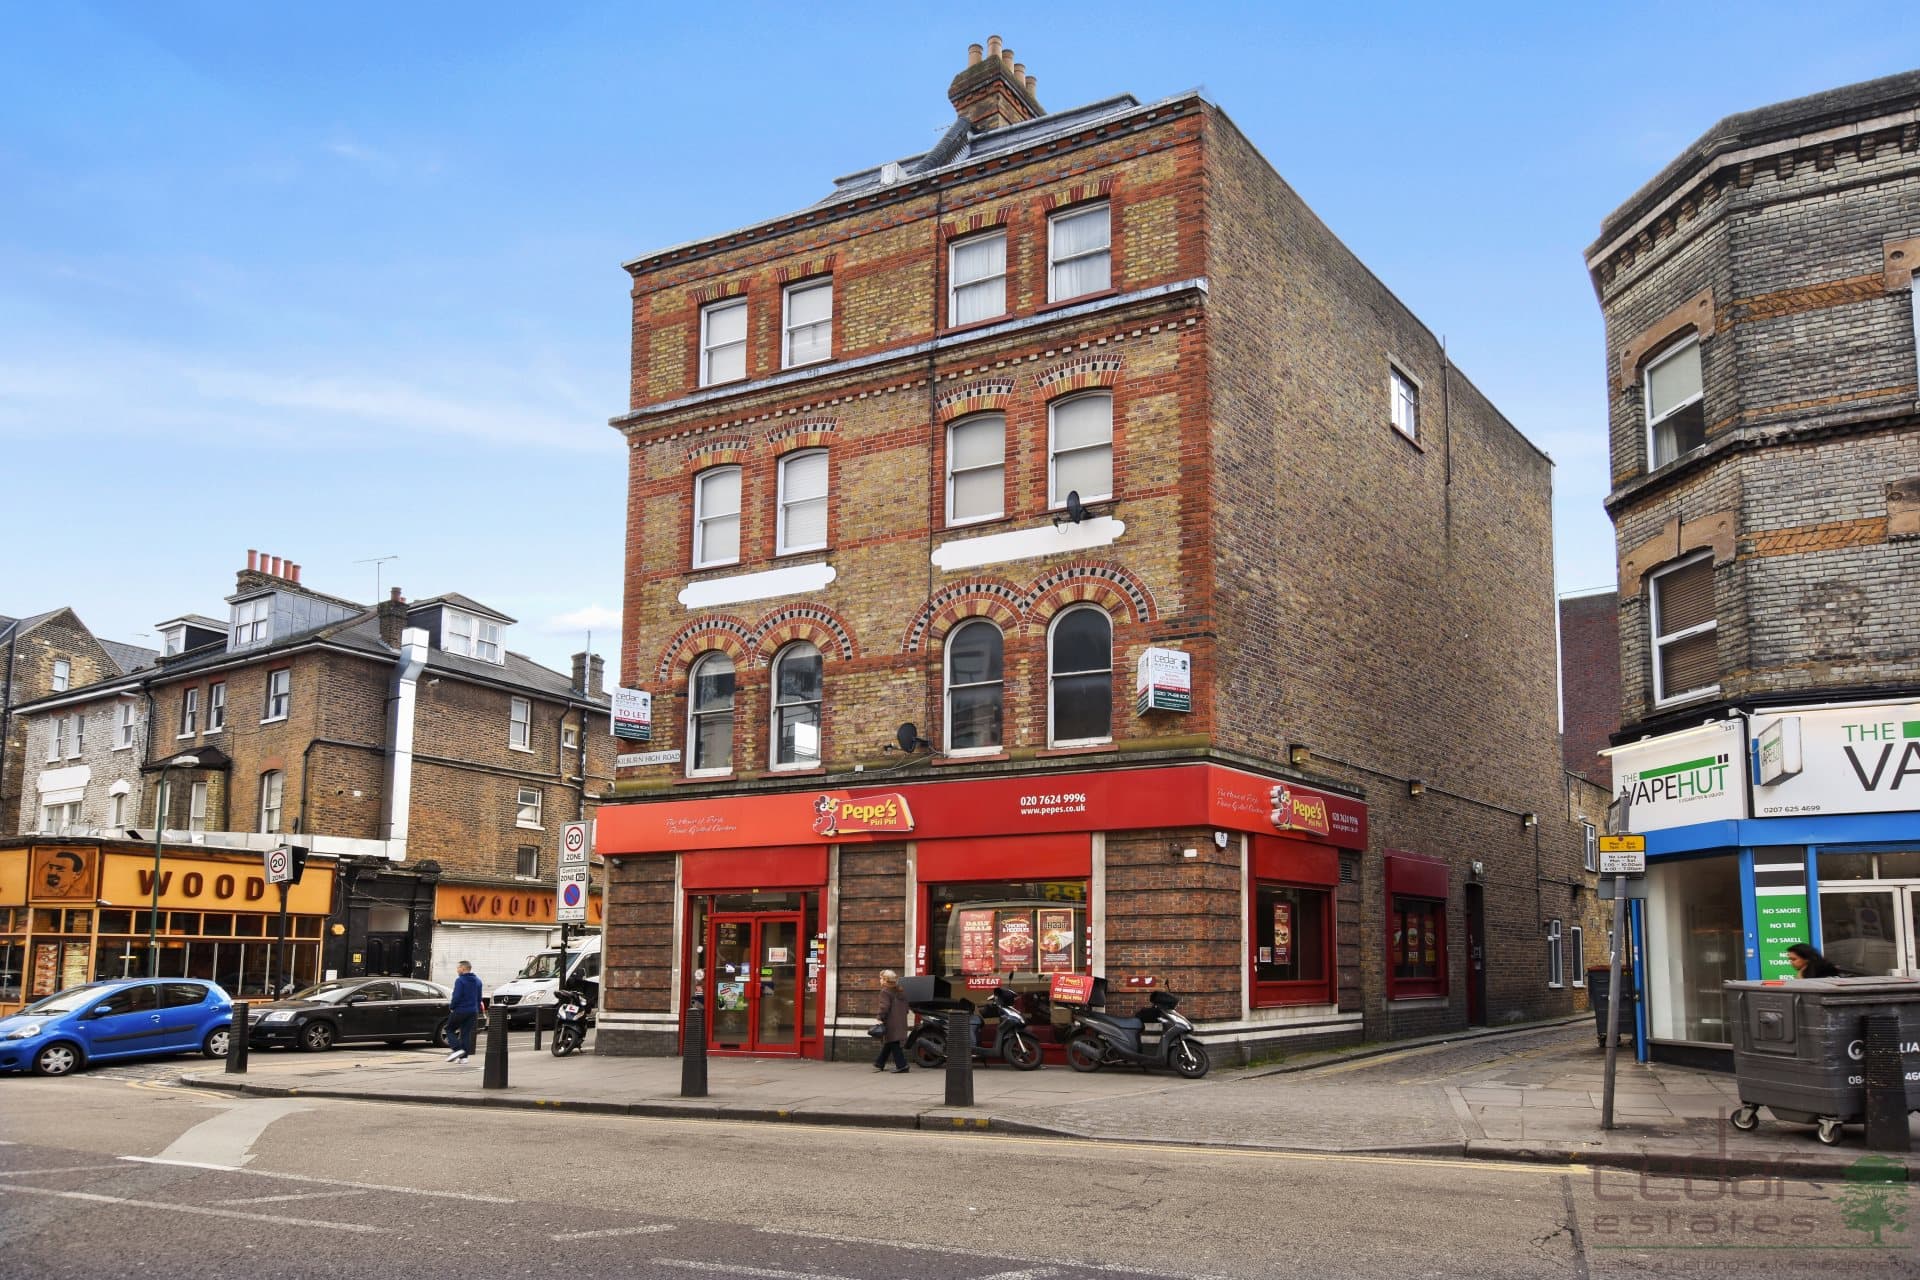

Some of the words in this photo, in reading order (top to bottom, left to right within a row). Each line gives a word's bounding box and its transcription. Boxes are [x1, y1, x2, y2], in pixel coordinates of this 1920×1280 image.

[616, 689, 639, 700] cedar
[1841, 722, 1896, 742] THE
[662, 751, 680, 760] ROAD
[1622, 772, 1638, 783] THE
[1020, 796, 1037, 806] 020
[1039, 795, 1061, 804] 7624
[1063, 793, 1086, 803] 9996
[842, 799, 897, 823] Pepe's
[1021, 804, 1086, 815] www.pepes.co.uk
[1293, 800, 1322, 820] Pepe's
[568, 834, 580, 844] 20
[272, 858, 284, 867] 20
[566, 853, 582, 861] ZONE
[138, 868, 289, 903] WOOD
[1848, 1075, 1864, 1085] 08
[1905, 1072, 1920, 1081] 46
